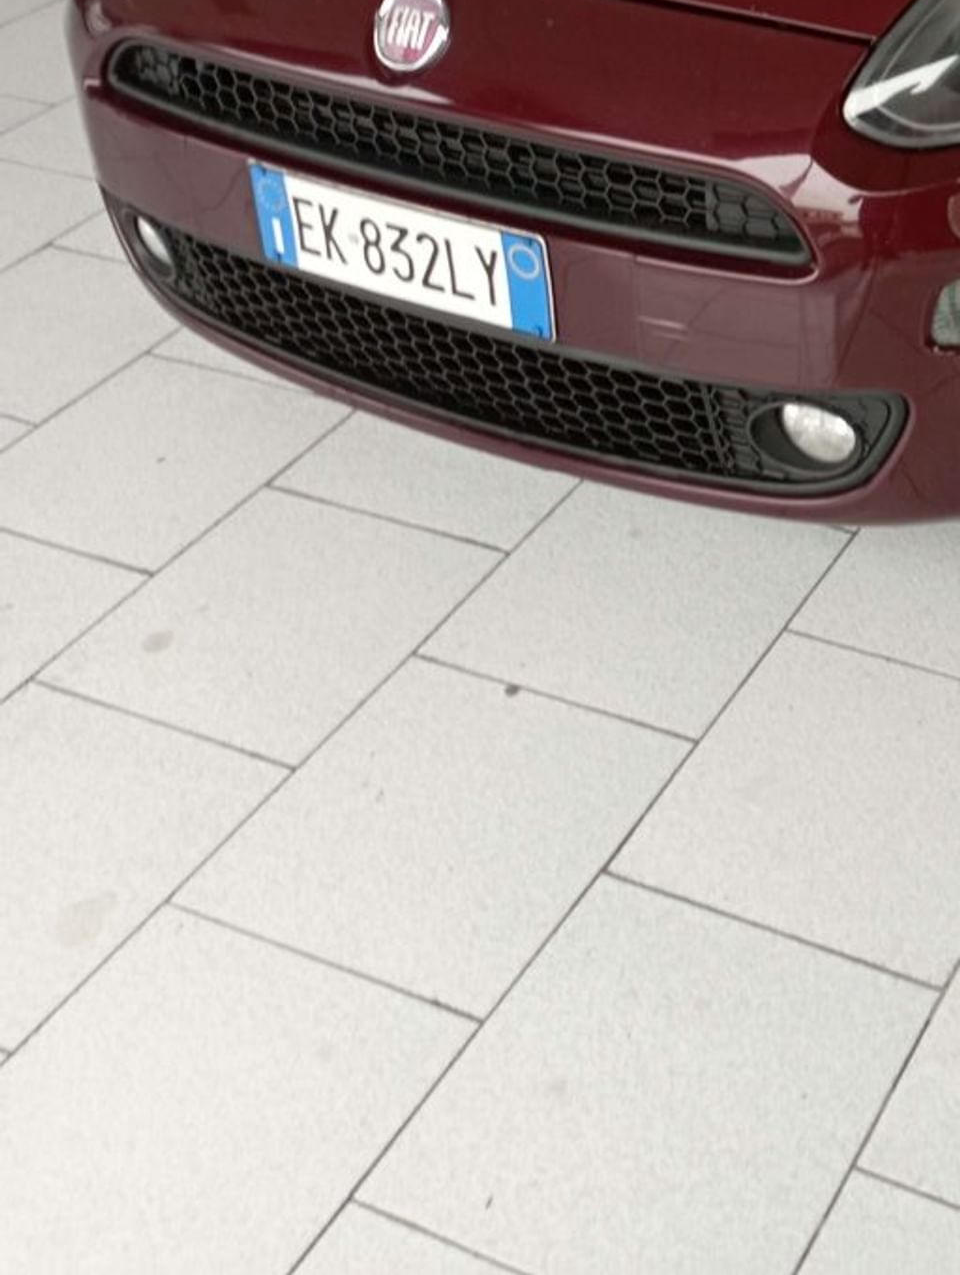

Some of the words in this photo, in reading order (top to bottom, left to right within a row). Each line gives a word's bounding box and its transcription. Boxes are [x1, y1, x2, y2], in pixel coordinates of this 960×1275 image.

[386, 6, 435, 50] FIAT
[292, 196, 348, 266] EK
[359, 218, 498, 307] 832LY
